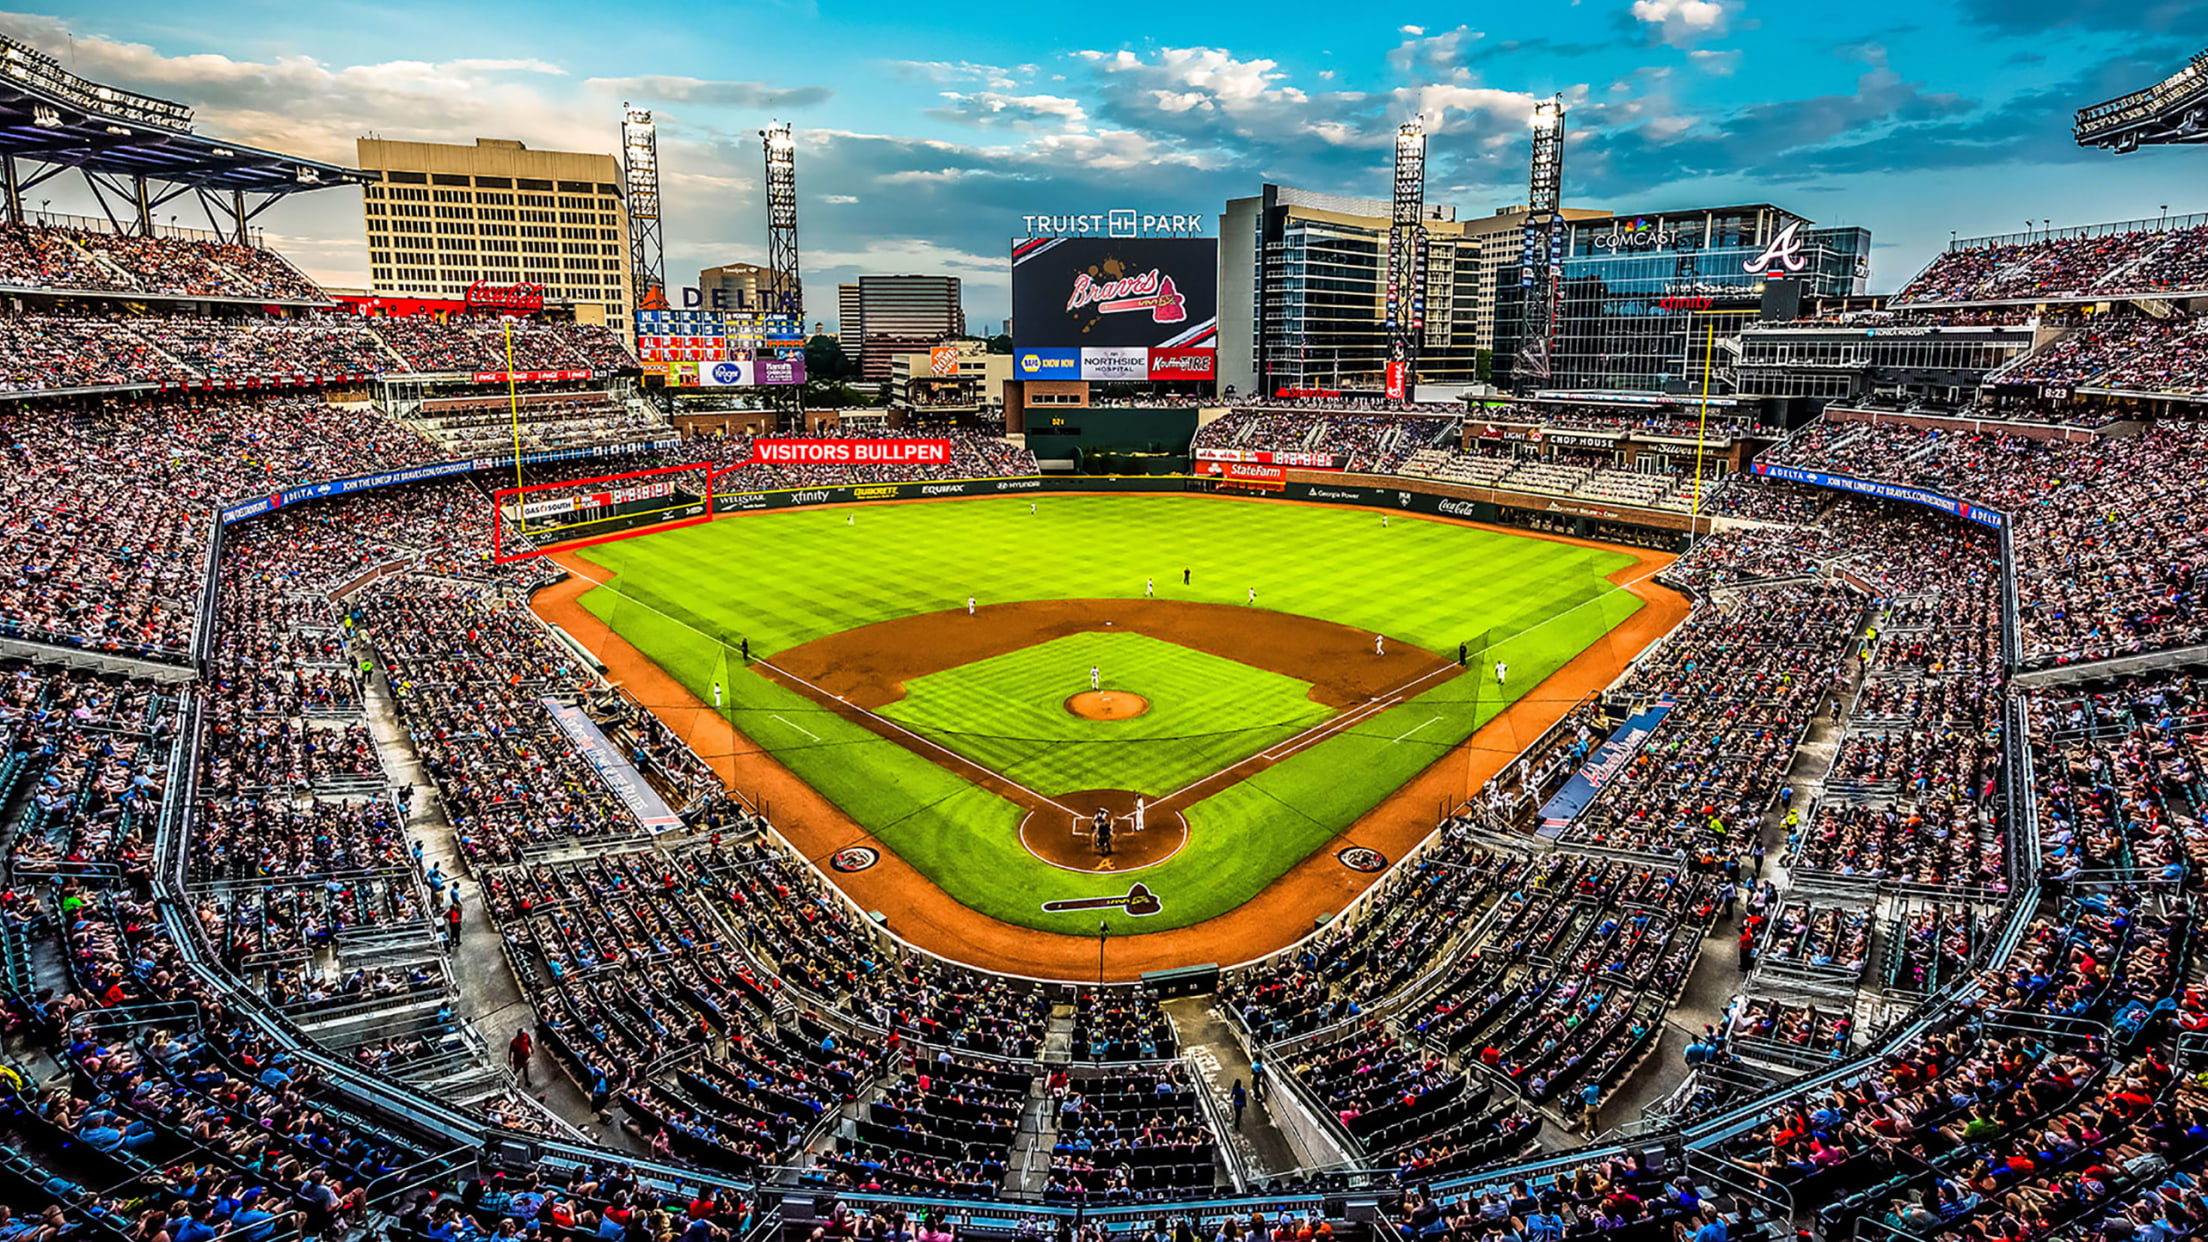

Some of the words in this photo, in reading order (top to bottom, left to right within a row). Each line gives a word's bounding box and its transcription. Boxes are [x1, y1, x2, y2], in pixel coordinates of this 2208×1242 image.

[1022, 215, 1104, 233] TRUIST
[1143, 215, 1203, 233] PARK
[1594, 230, 1678, 249] COMCAST
[466, 279, 547, 309] Coca-Cola
[1066, 268, 1159, 311] Braves
[682, 287, 797, 310] DELTA
[1658, 295, 1714, 312] xfinity
[1084, 357, 1145, 366] NORTHSIDE
[713, 364, 740, 383] Kroger
[1290, 387, 1341, 399] StateFarm
[2044, 388, 2067, 399] 8:23
[1503, 431, 1526, 440] LIGHT
[1550, 435, 1577, 444] CHOP
[1579, 437, 1615, 448] HOUSE
[1231, 464, 1281, 477] StateFarm
[1777, 469, 1804, 480] DELTA
[921, 484, 965, 495] EQUIFAX
[1009, 481, 1041, 489] HYUNDAI
[288, 489, 313, 502] DELTA
[791, 491, 830, 504] xfinity
[1318, 489, 1340, 499] Georgia
[1341, 491, 1360, 499] Power
[524, 505, 540, 516] GAS
[547, 501, 571, 513] SOUTH
[1976, 512, 2001, 526] DELTA
